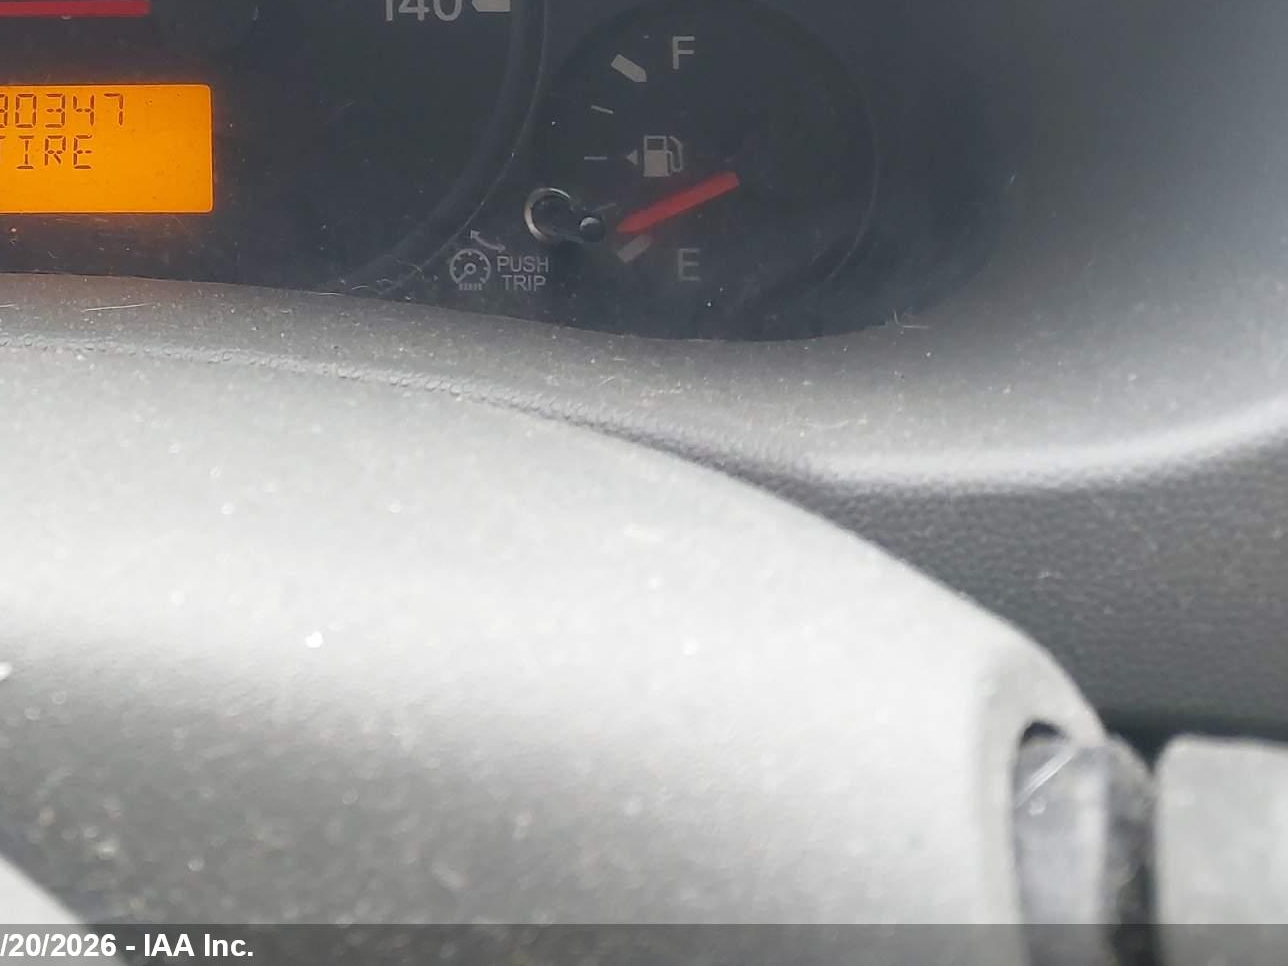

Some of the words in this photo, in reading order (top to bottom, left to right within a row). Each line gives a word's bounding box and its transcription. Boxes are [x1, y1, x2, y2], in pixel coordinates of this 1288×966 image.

[671, 35, 696, 70] F
[496, 255, 549, 273] PUSH
[677, 247, 701, 282] E
[501, 274, 546, 291] TRIP
